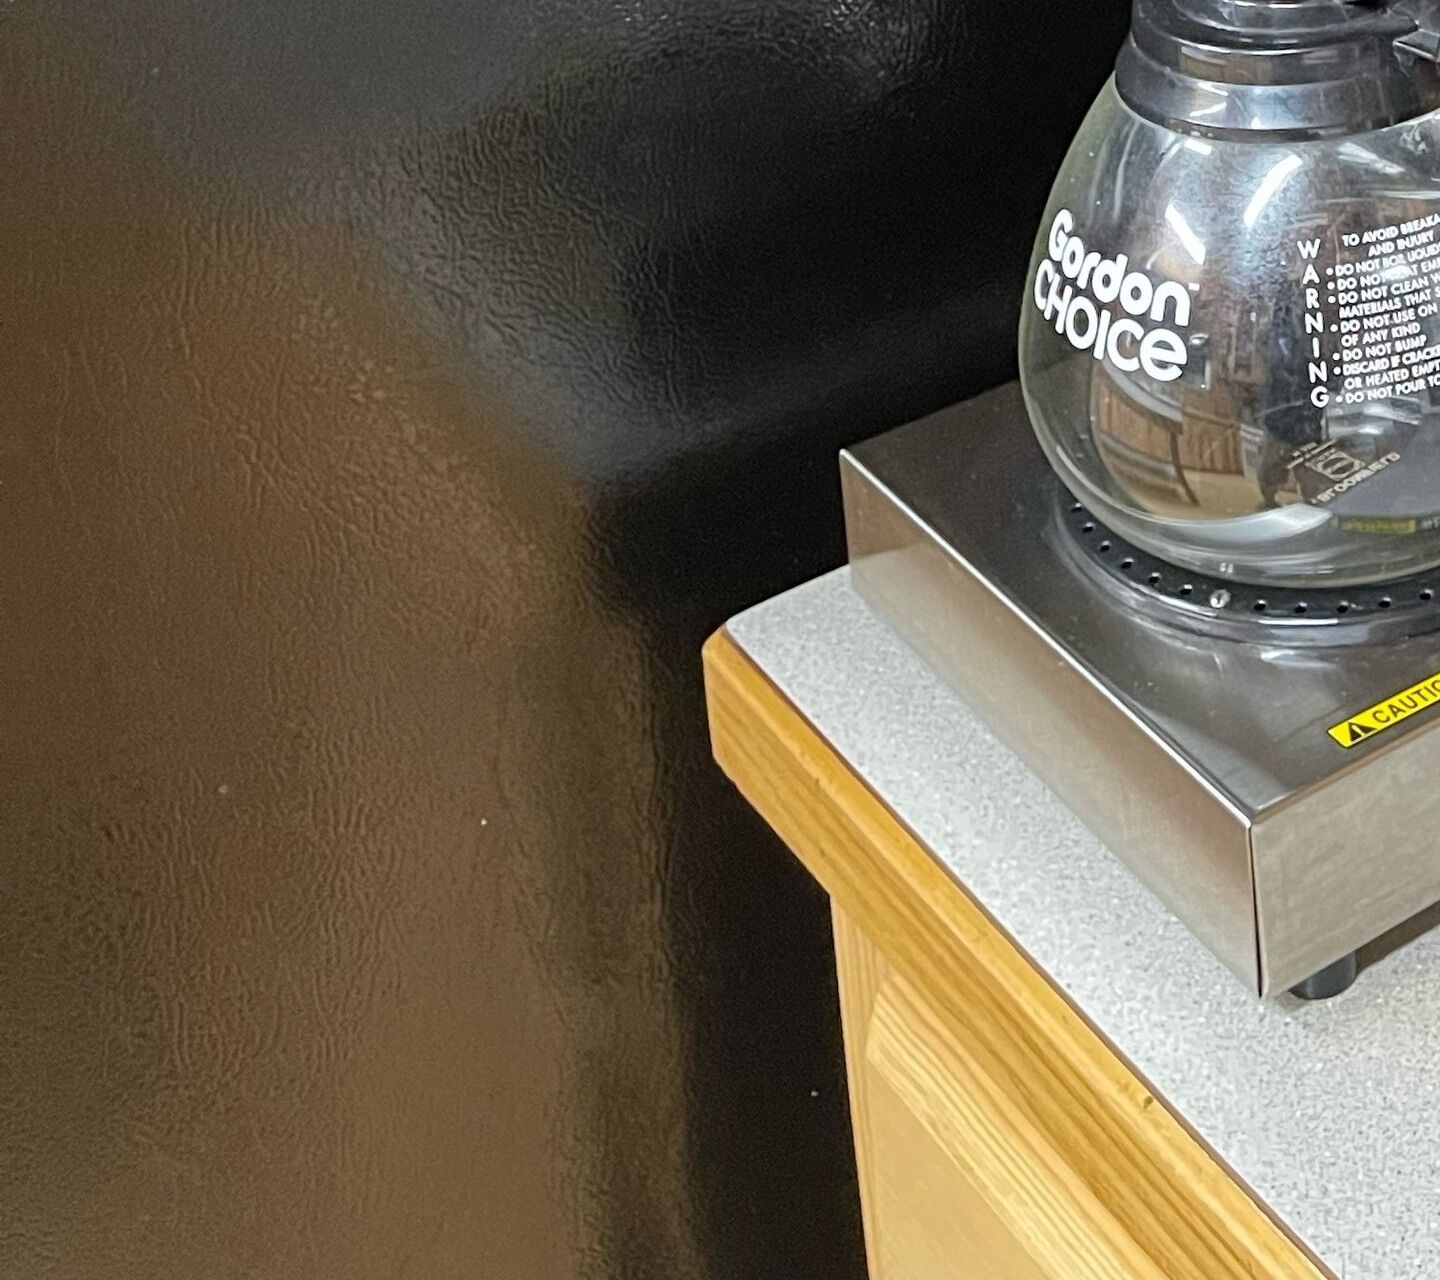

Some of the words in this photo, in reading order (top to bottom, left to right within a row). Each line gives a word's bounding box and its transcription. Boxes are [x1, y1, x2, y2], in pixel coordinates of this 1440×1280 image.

[1342, 231, 1359, 248] TO
[1362, 224, 1398, 245] AVOID
[1368, 239, 1394, 257] AND
[1049, 209, 1191, 326] Gordon
[1335, 261, 1354, 278] DO
[1356, 256, 1379, 275] NOT
[1337, 275, 1356, 292] DO
[1338, 290, 1358, 305] DO
[1361, 285, 1387, 301] NOT
[1390, 277, 1428, 295] CLEAN
[1404, 289, 1430, 306] THAT
[1297, 238, 1329, 407] WARNING
[1340, 317, 1360, 334] DO
[1363, 312, 1389, 330] NOT
[1392, 306, 1415, 324] USE
[1418, 301, 1437, 318] ON
[1341, 333, 1358, 347] OF
[1362, 328, 1387, 344] ANY
[1391, 322, 1420, 338] KIND
[1342, 347, 1362, 361] DO
[1365, 341, 1391, 358] NOT
[1344, 375, 1361, 390] OR
[1365, 367, 1408, 386] HEATED
[1345, 388, 1363, 405] DO
[1368, 383, 1393, 402] NOT
